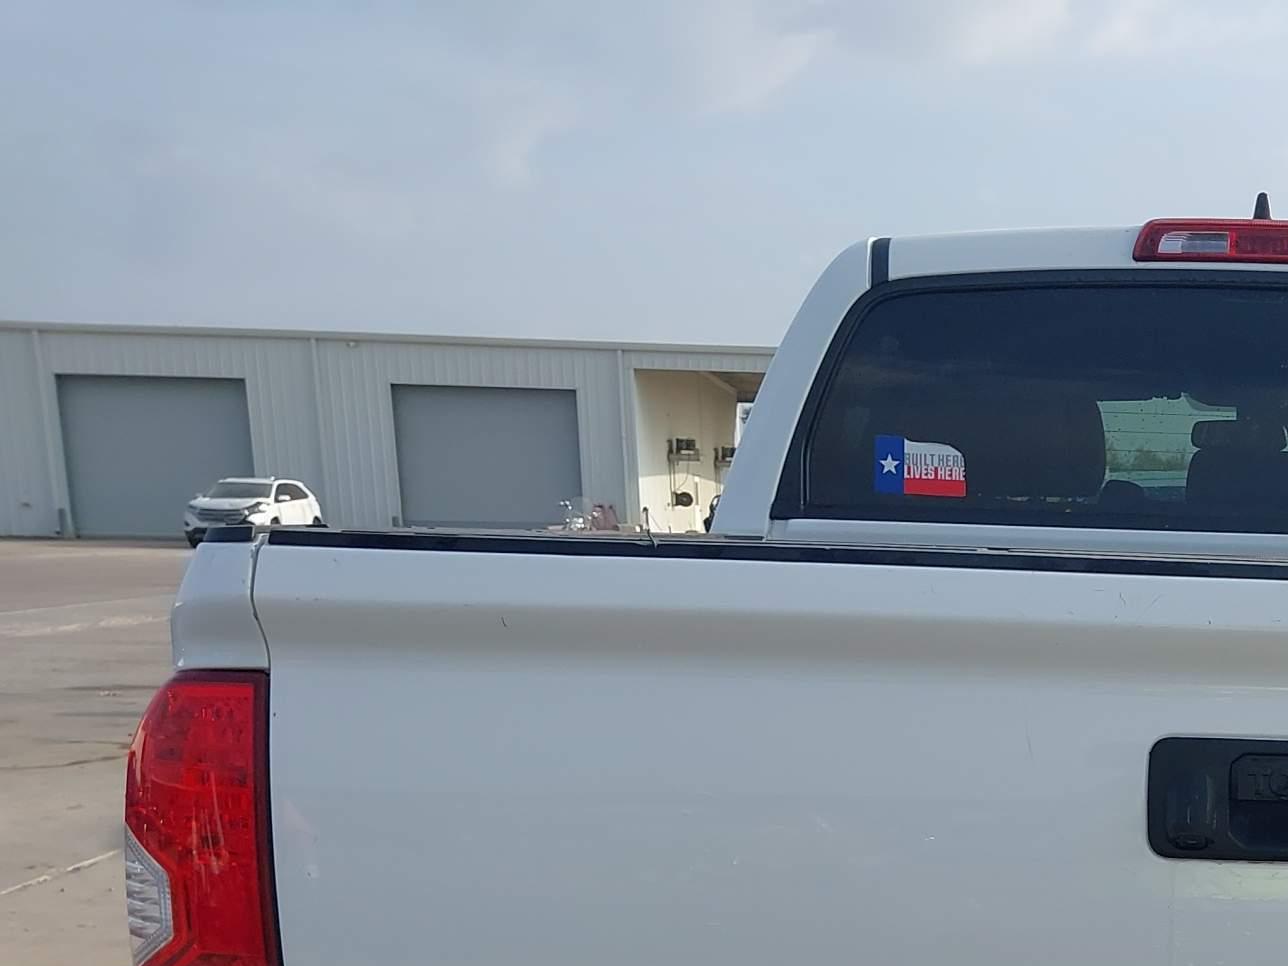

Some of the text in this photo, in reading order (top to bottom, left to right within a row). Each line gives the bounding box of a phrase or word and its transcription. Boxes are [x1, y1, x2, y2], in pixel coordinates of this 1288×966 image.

[904, 452, 936, 467] BUILT
[904, 464, 966, 481] LIVES HERE
